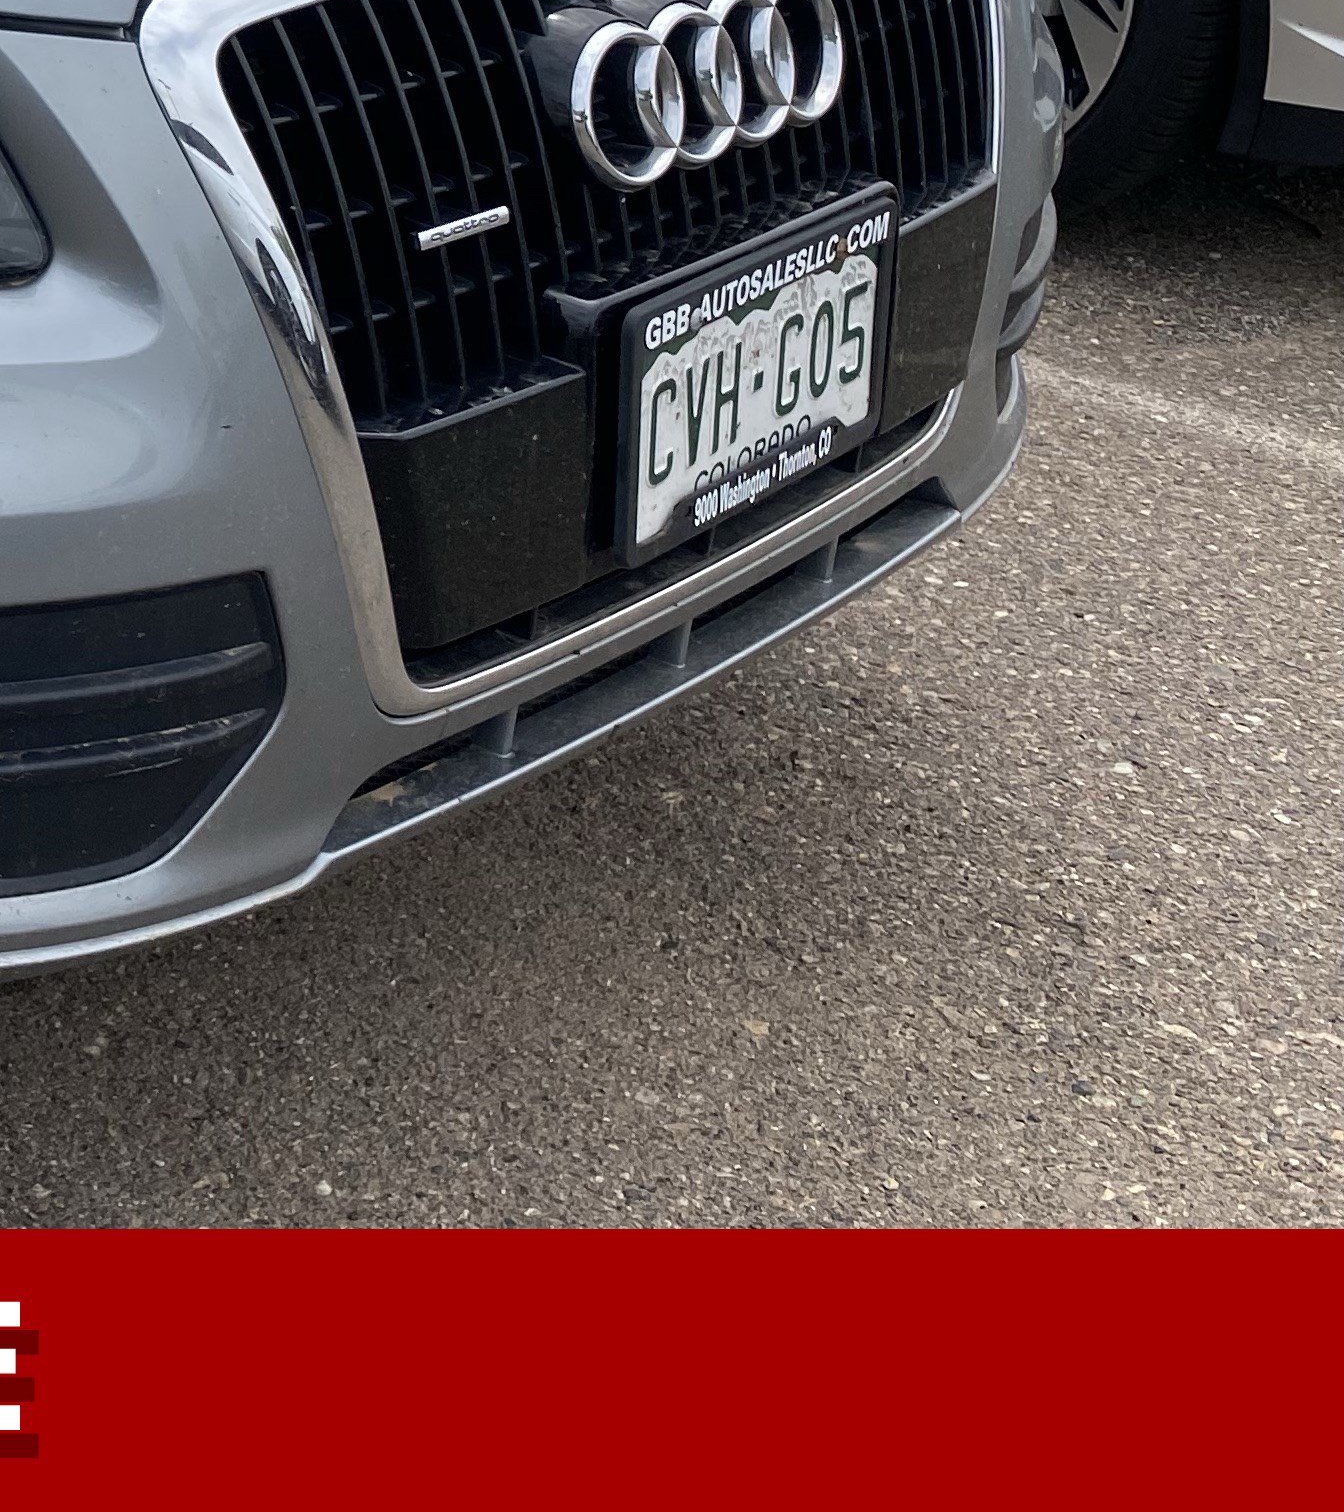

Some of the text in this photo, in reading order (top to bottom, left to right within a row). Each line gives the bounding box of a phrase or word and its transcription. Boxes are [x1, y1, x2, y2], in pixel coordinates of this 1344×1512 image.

[430, 213, 500, 243] quattro
[694, 488, 719, 527] 9000
[719, 468, 771, 504] Washington
[818, 426, 832, 459] CO
